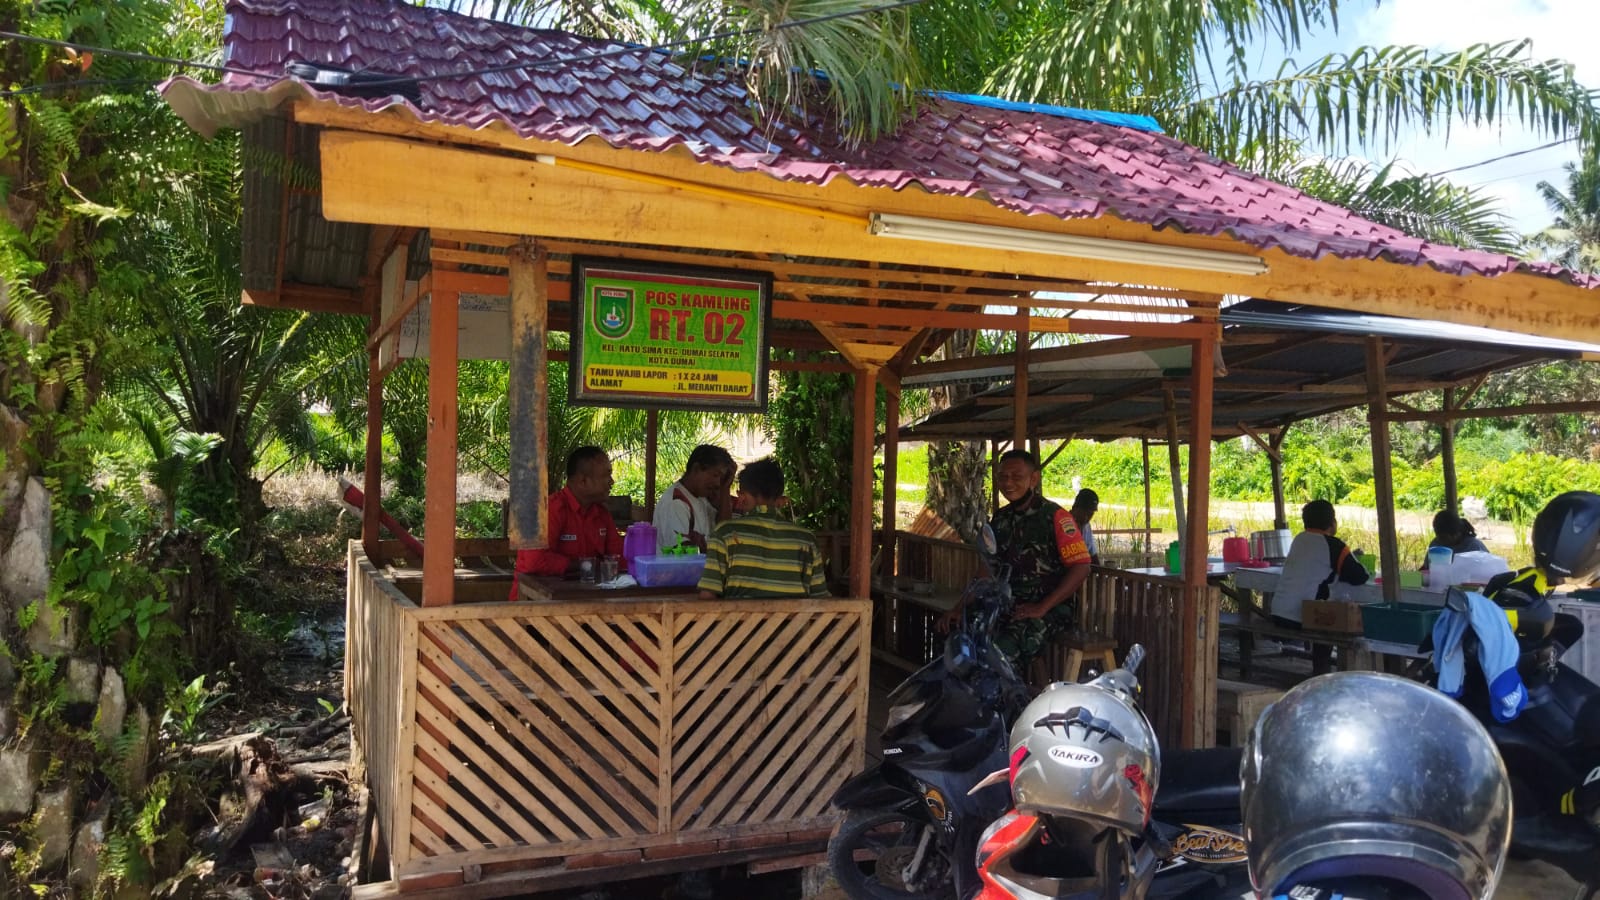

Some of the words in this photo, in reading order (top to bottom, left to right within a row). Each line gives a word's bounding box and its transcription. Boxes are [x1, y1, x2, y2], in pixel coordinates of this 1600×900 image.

[646, 290, 677, 306] POS
[681, 293, 751, 311] KAMLING
[649, 308, 695, 343] RT.
[704, 311, 745, 345] 02
[682, 348, 707, 357] DUMAI
[708, 350, 740, 358] SELATAN
[649, 356, 669, 364] KOTA
[671, 358, 696, 366] DUMAI
[590, 368, 613, 377] TAMU
[616, 369, 641, 378] WAJIB
[643, 371, 668, 379] LAPOR
[691, 373, 701, 381] 24
[703, 374, 718, 382] JAM
[590, 378, 623, 388] ALAMAT
[688, 383, 722, 392] MERANTI
